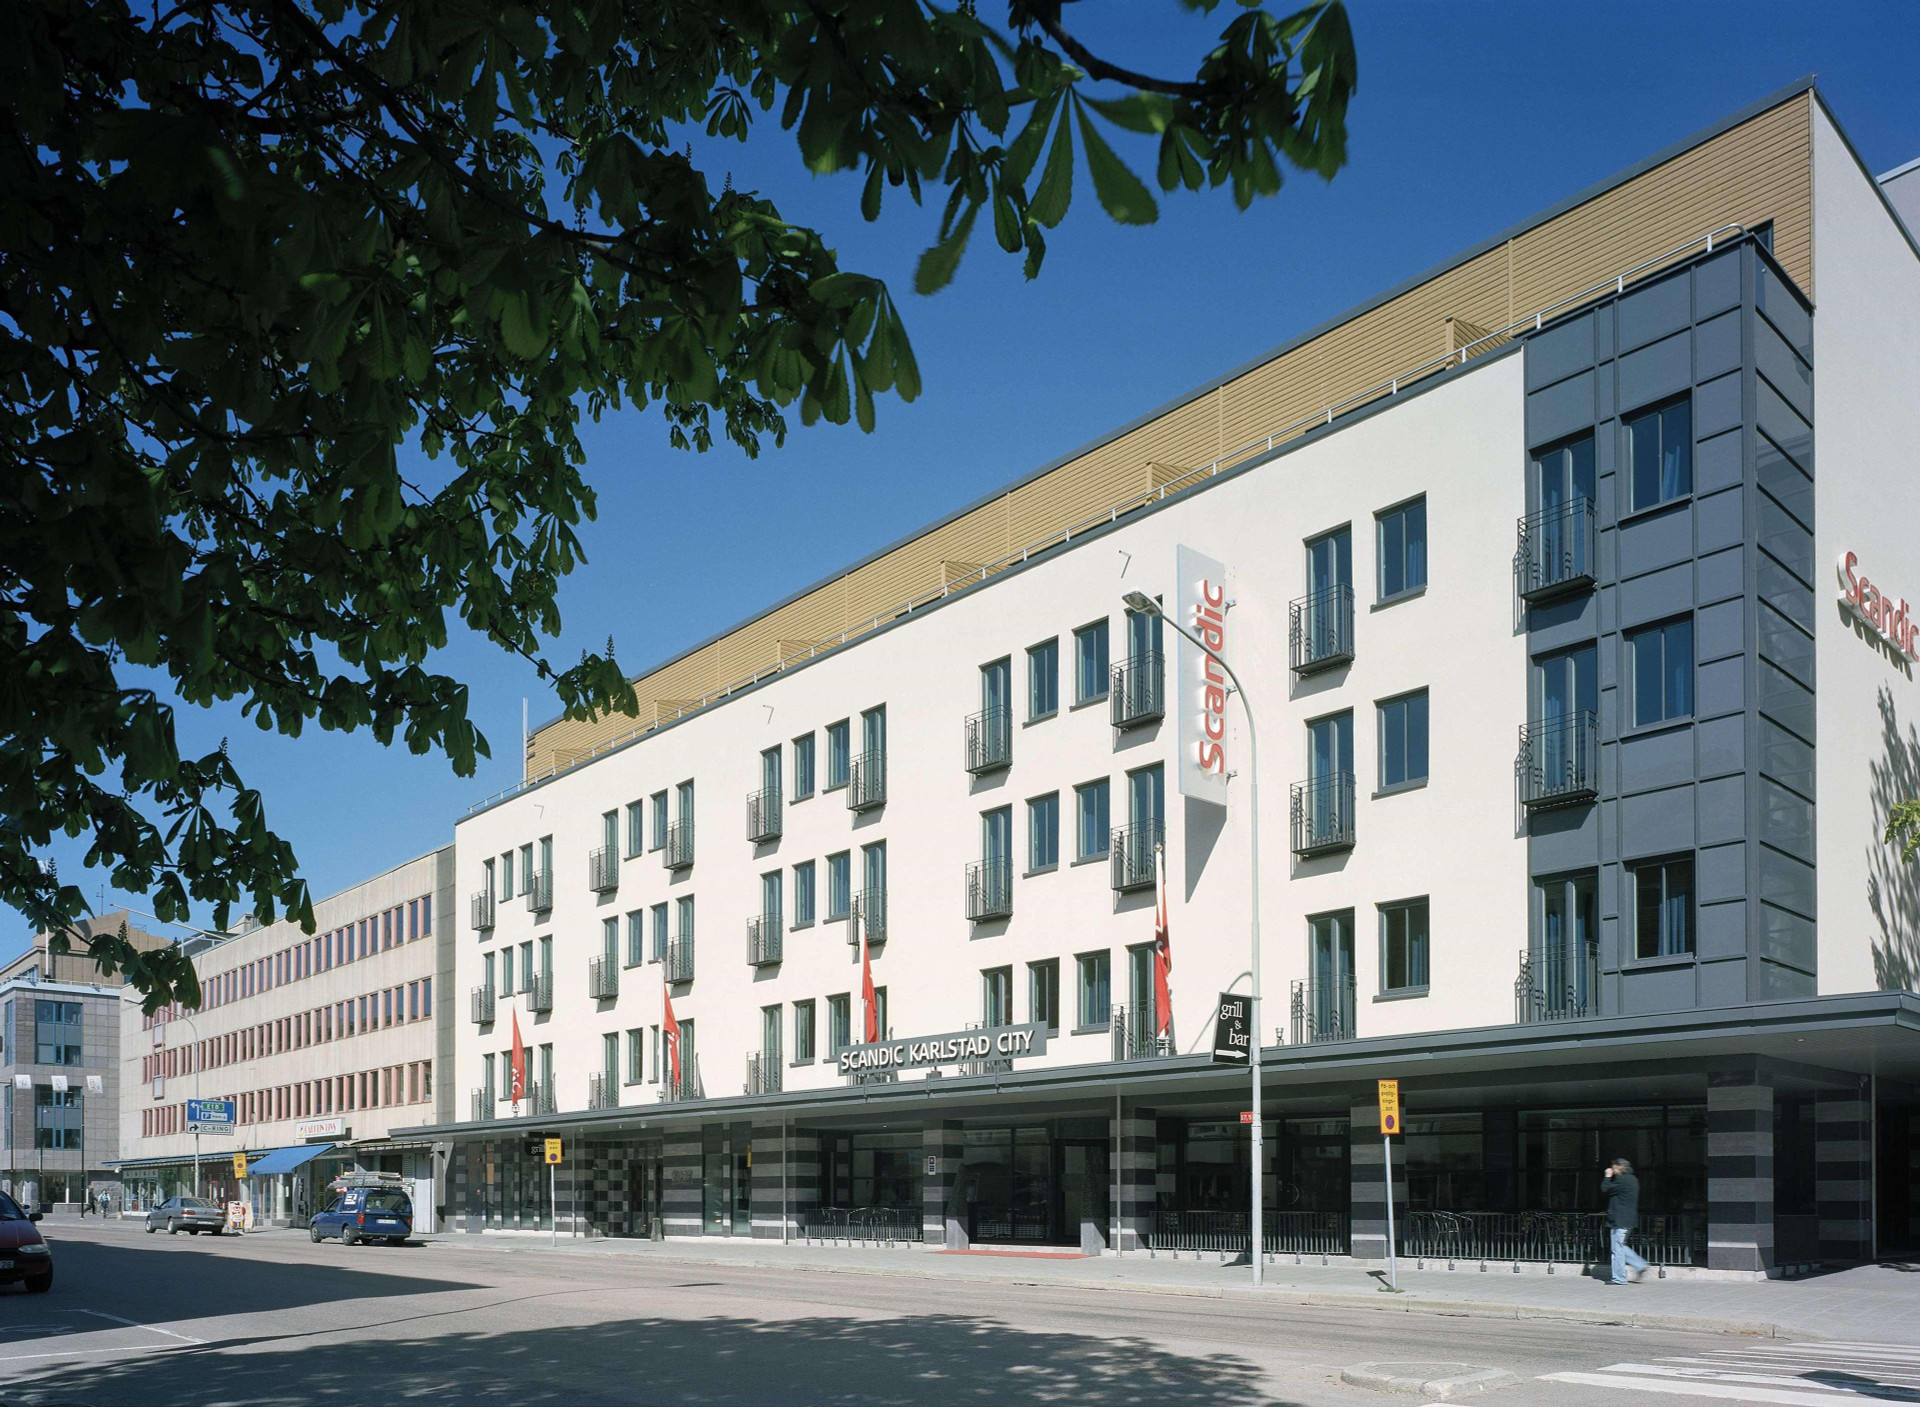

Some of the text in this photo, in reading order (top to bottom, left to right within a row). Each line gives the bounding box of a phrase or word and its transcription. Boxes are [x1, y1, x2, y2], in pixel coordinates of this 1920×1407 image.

[1844, 551, 1920, 662] Scandic
[1219, 1001, 1243, 1020] grill
[1234, 1020, 1242, 1030] &
[1228, 1028, 1249, 1046] bar
[840, 1029, 1035, 1071] SCANDIC KARLSTAD CITY
